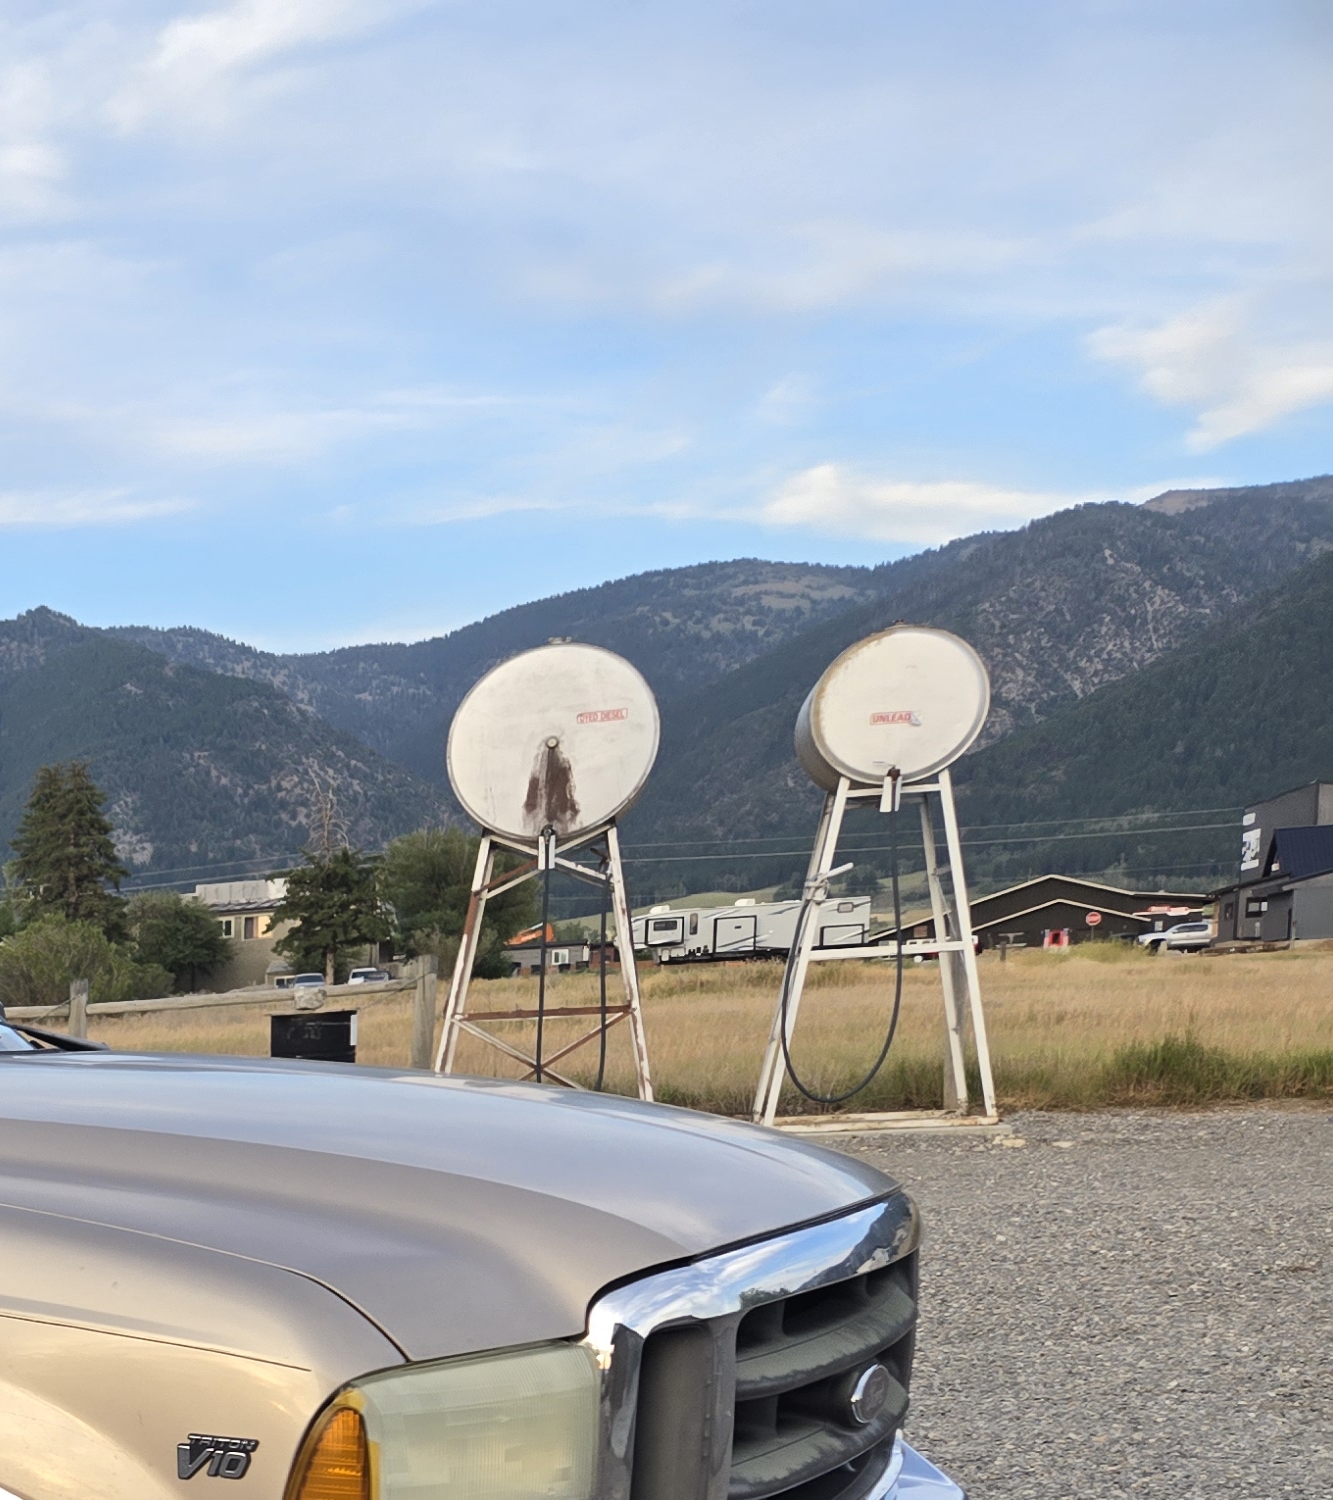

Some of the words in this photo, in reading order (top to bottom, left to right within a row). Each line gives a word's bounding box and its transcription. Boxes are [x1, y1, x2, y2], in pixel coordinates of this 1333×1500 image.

[600, 710, 625, 721] DIESEL
[873, 712, 912, 723] UNLEAD
[188, 1435, 256, 1451] TRITON
[177, 1445, 249, 1479] V10
